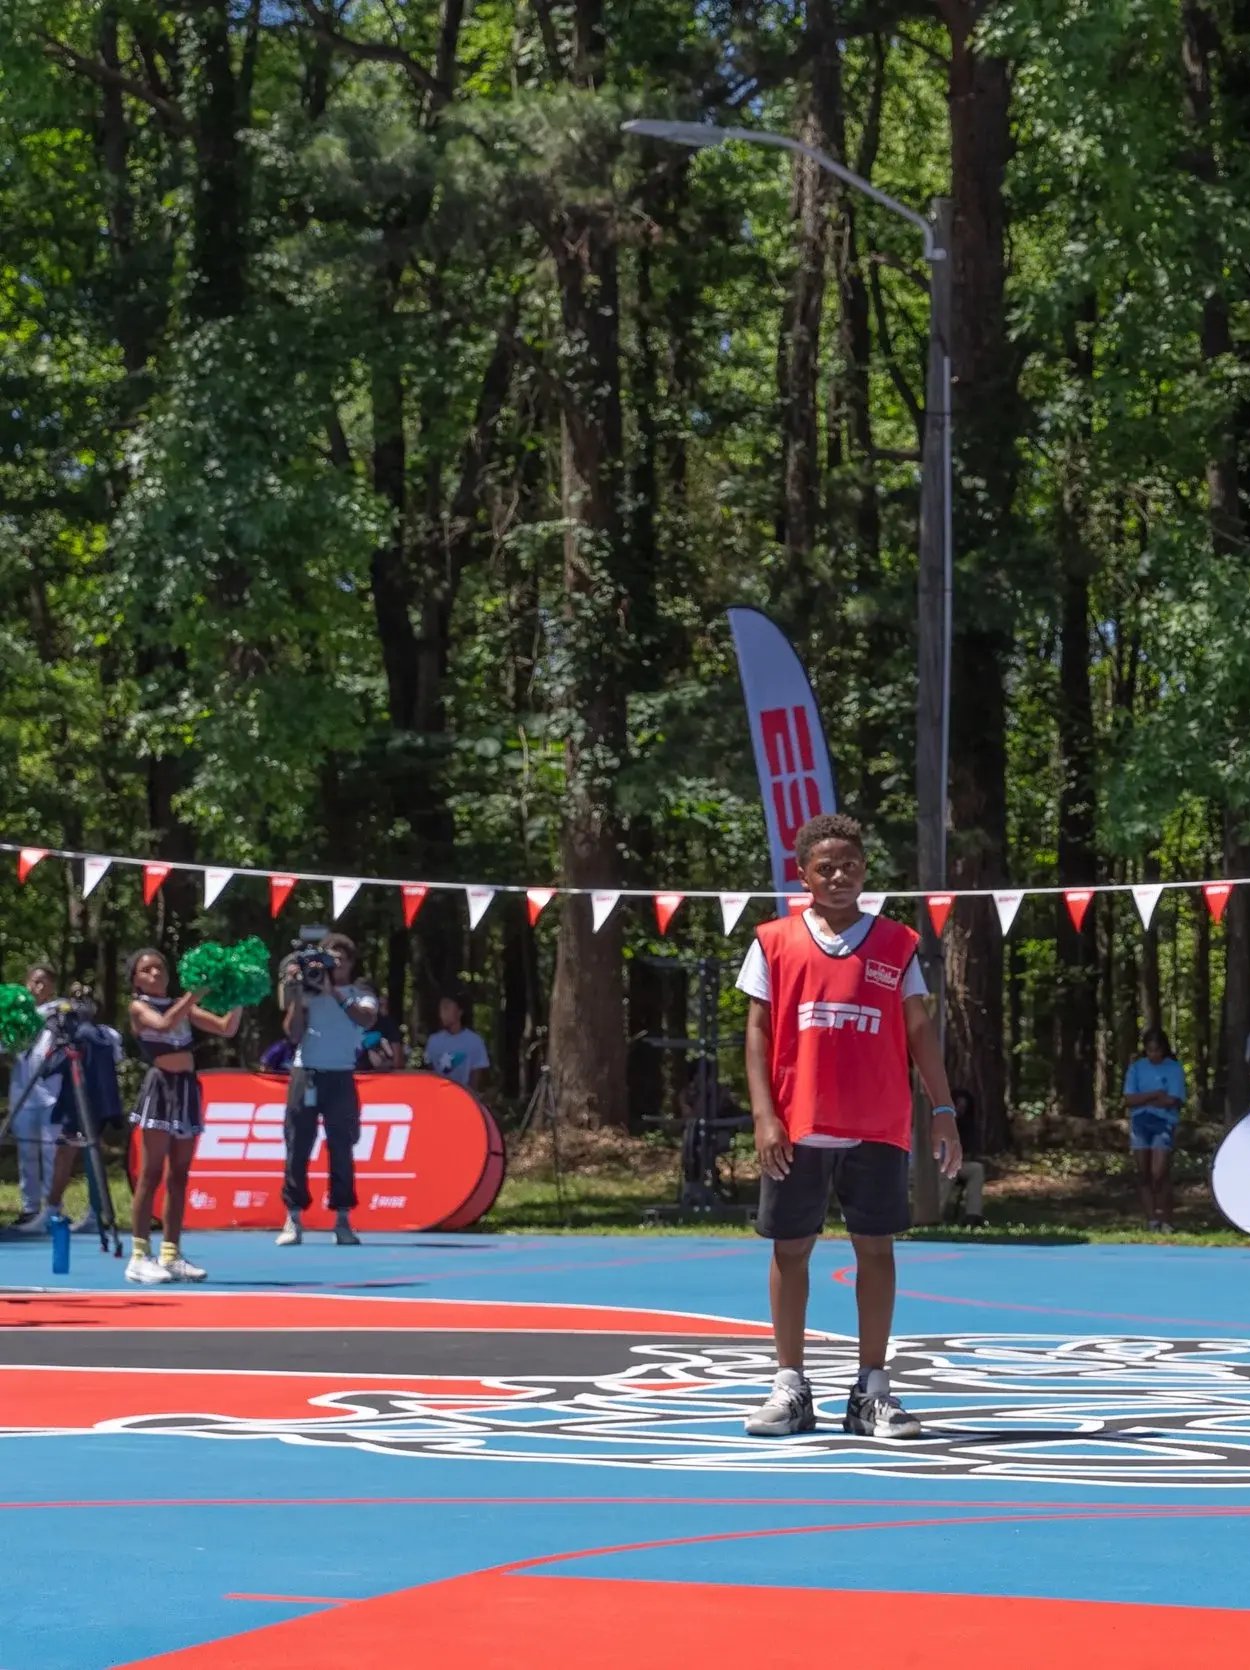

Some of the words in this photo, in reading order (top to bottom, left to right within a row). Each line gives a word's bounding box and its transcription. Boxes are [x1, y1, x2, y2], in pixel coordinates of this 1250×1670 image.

[760, 706, 822, 882] ES
[798, 1001, 882, 1034] ESPN
[194, 1102, 413, 1161] ESN
